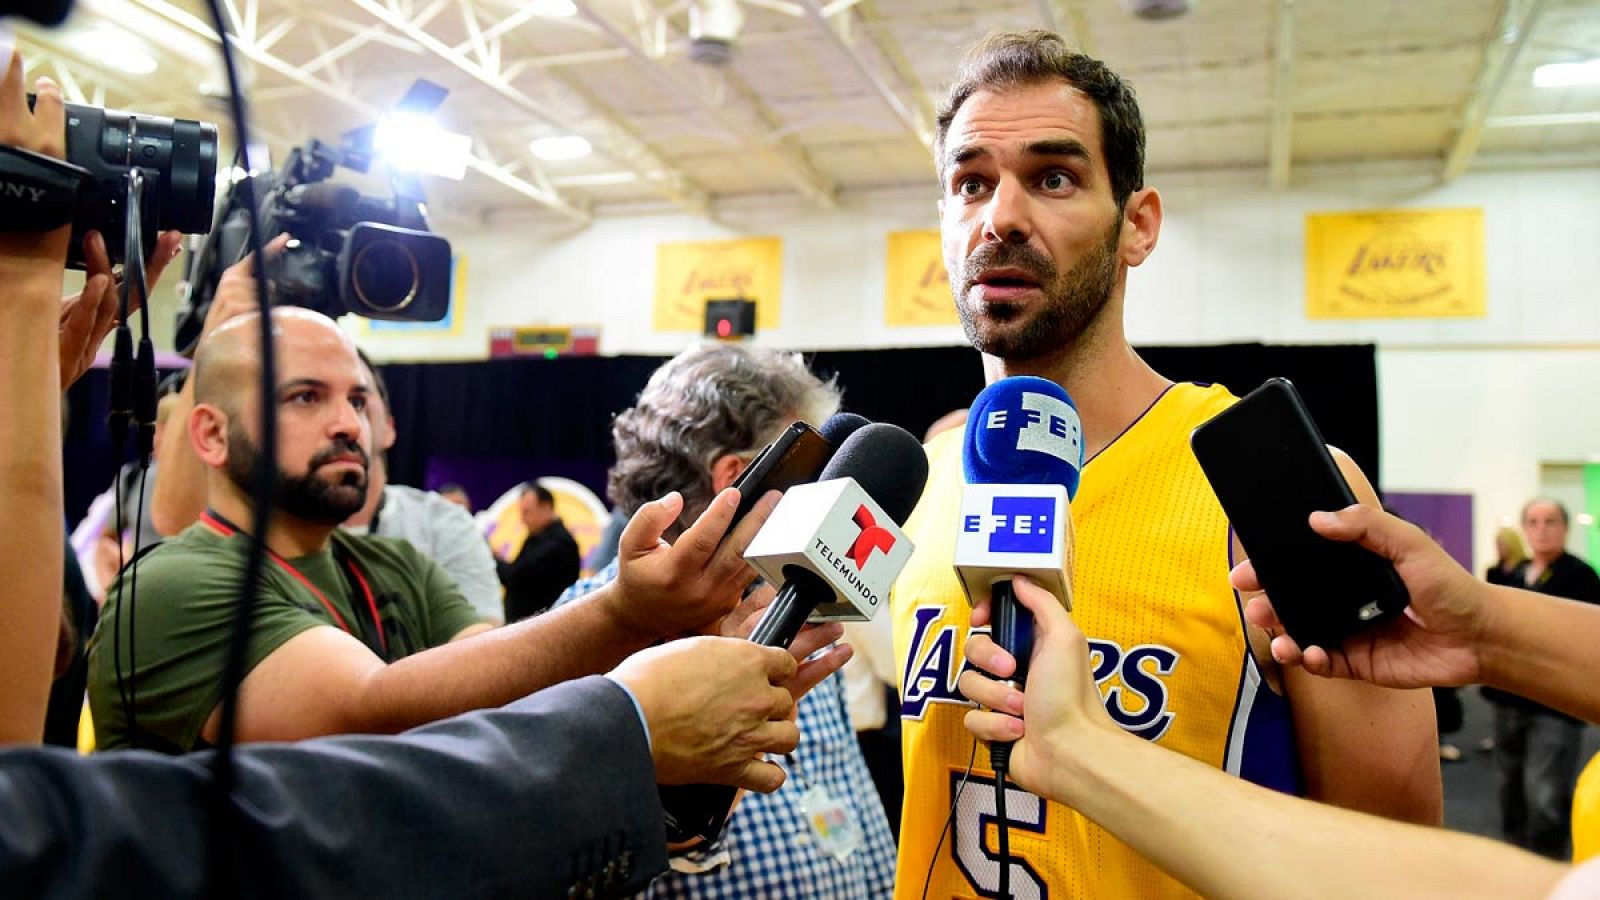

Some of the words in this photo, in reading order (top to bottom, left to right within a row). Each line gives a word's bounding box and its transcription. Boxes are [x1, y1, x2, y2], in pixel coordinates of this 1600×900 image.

[0, 181, 46, 202] NY
[815, 538, 878, 606] TELEMUNDO
[900, 604, 1180, 741] LAS
